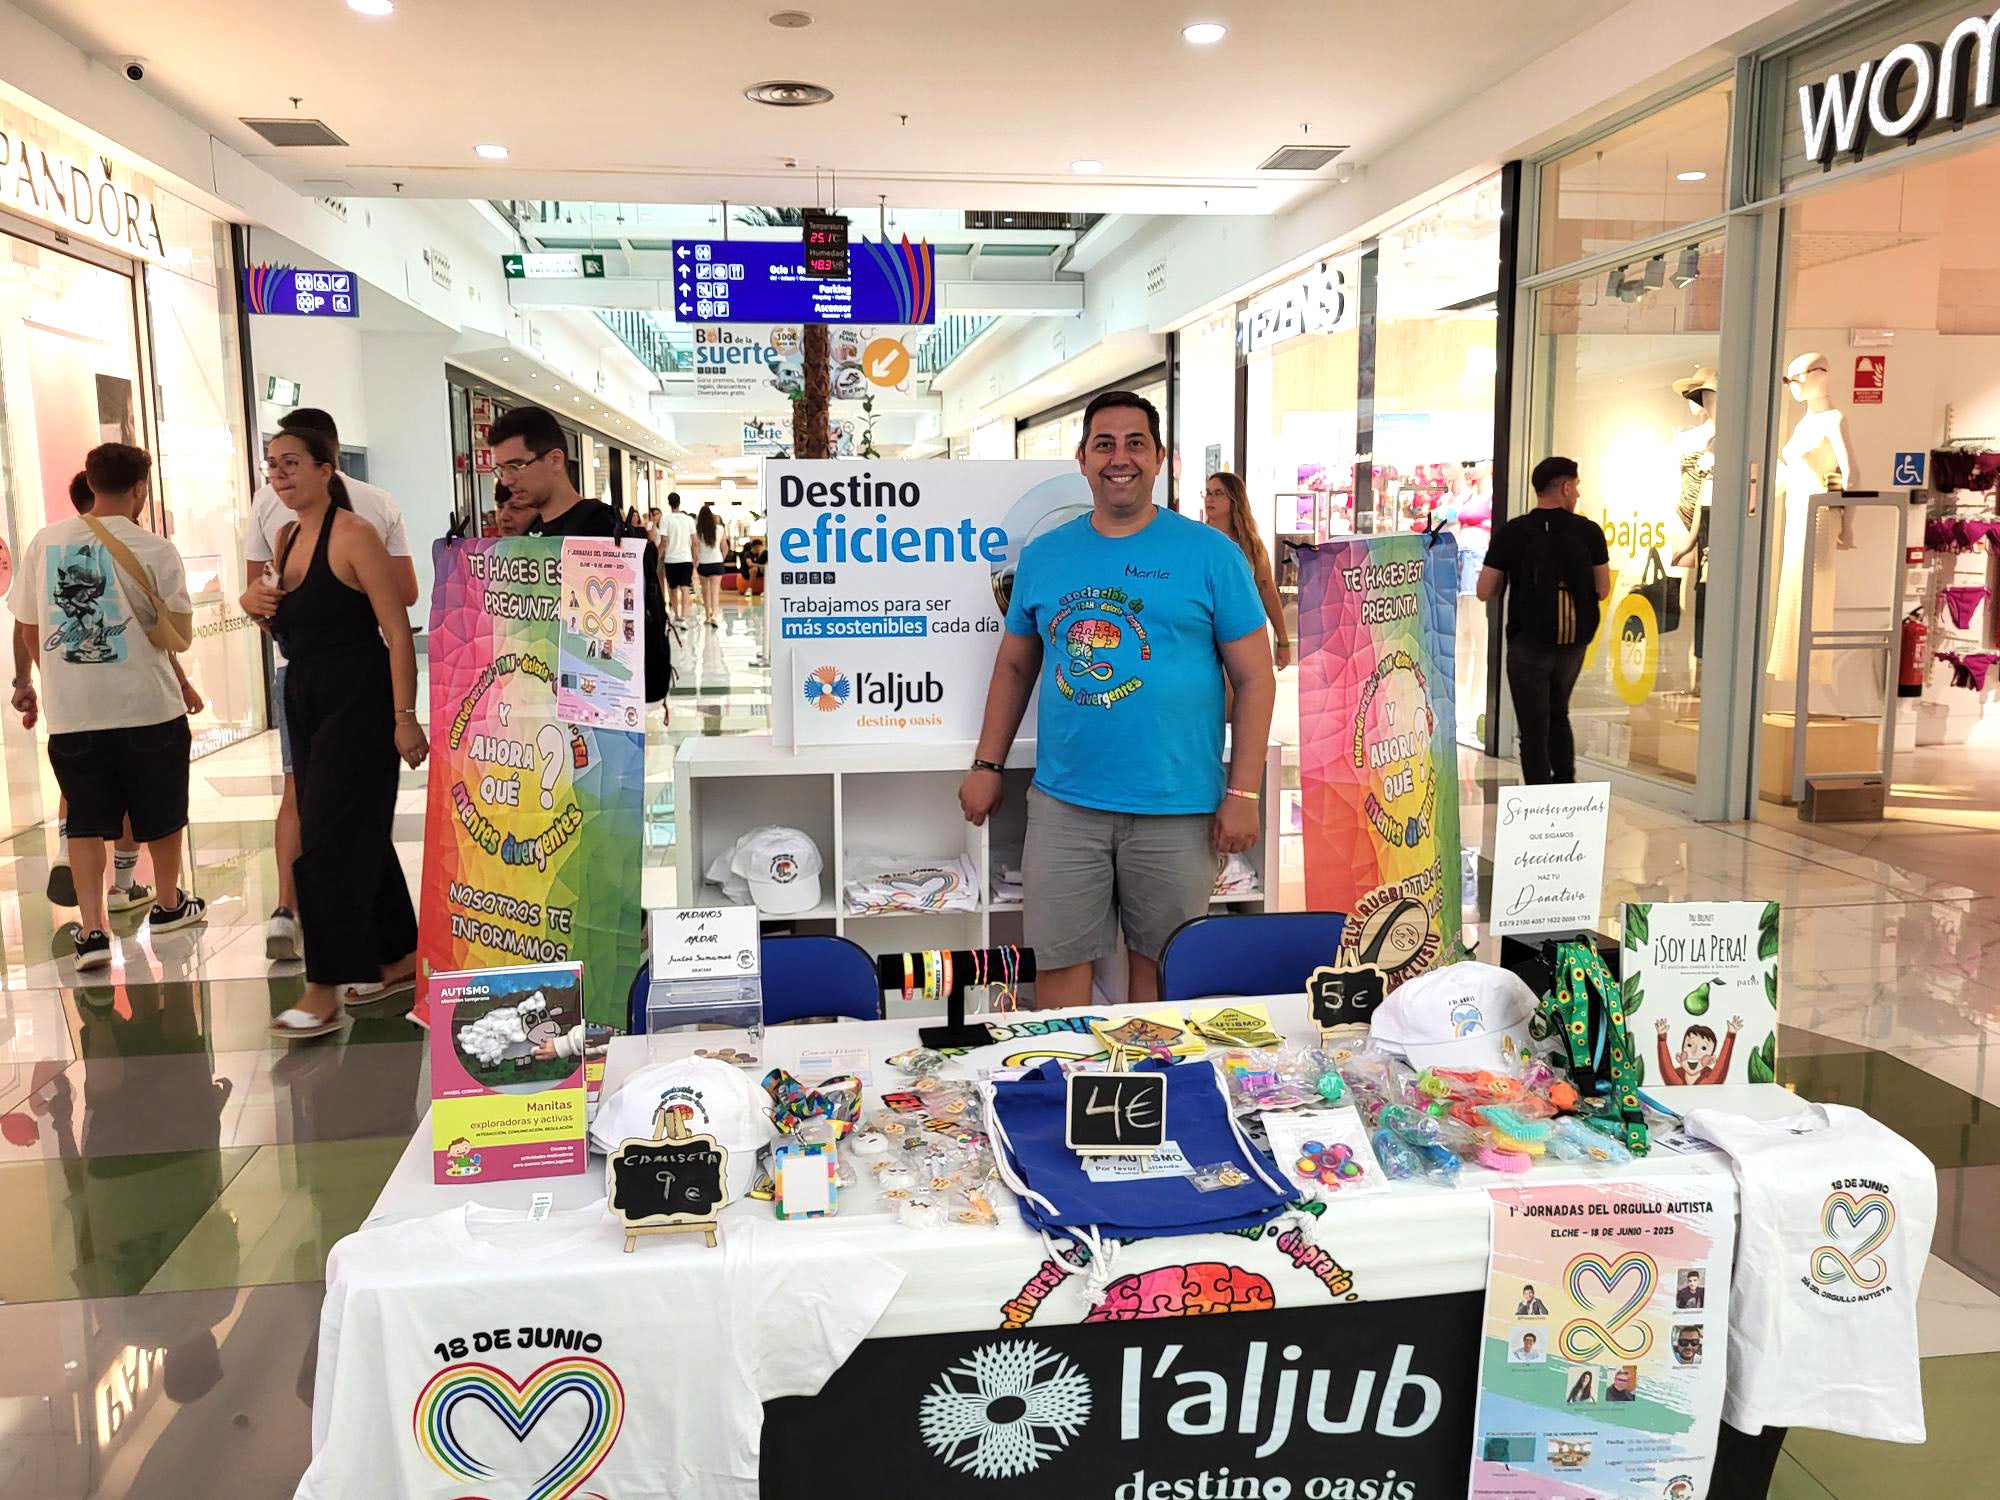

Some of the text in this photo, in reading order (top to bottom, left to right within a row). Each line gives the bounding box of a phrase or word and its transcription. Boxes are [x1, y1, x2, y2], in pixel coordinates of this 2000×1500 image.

[814, 303, 852, 313] Ascensor
[697, 342, 779, 364] suerte
[780, 472, 921, 507] Destino
[779, 513, 1009, 564] eficiente
[1602, 509, 1666, 558] bajas
[468, 552, 562, 585] TE HACES ES
[1343, 559, 1425, 592] TE HACES EST
[780, 597, 951, 615] Trabajamos para ser
[1361, 594, 1419, 626] PREGUNTA
[193, 622, 225, 639] ANDORA
[785, 615, 1000, 635] más sostenibles cada día
[1076, 676, 1143, 710] divergentes
[499, 702, 512, 728] Y
[857, 714, 943, 729] destino oasis
[1385, 702, 1396, 726] Y
[468, 735, 535, 771] AHORA
[480, 772, 521, 807] QUÉ
[1383, 762, 1415, 803] QUÉ
[1561, 795, 1605, 820] ayudar
[452, 781, 584, 873] mentes divergentes
[1529, 832, 1574, 841] QUE SIGAMOS
[1514, 840, 1587, 868] creciendo
[449, 881, 572, 934] NOSOTROS TE
[1506, 884, 1587, 916] Donativo
[450, 914, 568, 963] INFORMAMOS
[698, 923, 705, 931] A
[684, 934, 719, 946] AYUDAR
[1690, 938, 1705, 962] LA
[440, 985, 490, 998] AUTISMO
[527, 1100, 573, 1112] Manitas
[1085, 1081, 1160, 1142] 4€
[470, 1117, 532, 1130] exploradoras
[540, 1113, 574, 1124] activas
[1831, 1178, 1889, 1194] 18 DE JUNIO
[1523, 1204, 1584, 1217] JORNADAS
[1588, 1204, 1610, 1216] DEL
[1614, 1203, 1662, 1215] ORGULLO
[1667, 1201, 1714, 1214] AUTISTA
[1551, 1226, 1674, 1238] ELCHE 18 DE JUNIO 2025
[1809, 1285, 1820, 1295] DEL
[1820, 1291, 1857, 1303] ORGULLO
[1857, 1284, 1893, 1302] AUTISTA
[434, 1327, 603, 1362] 18 DE JUNIO
[1304, 1469, 1416, 1500] oasis
